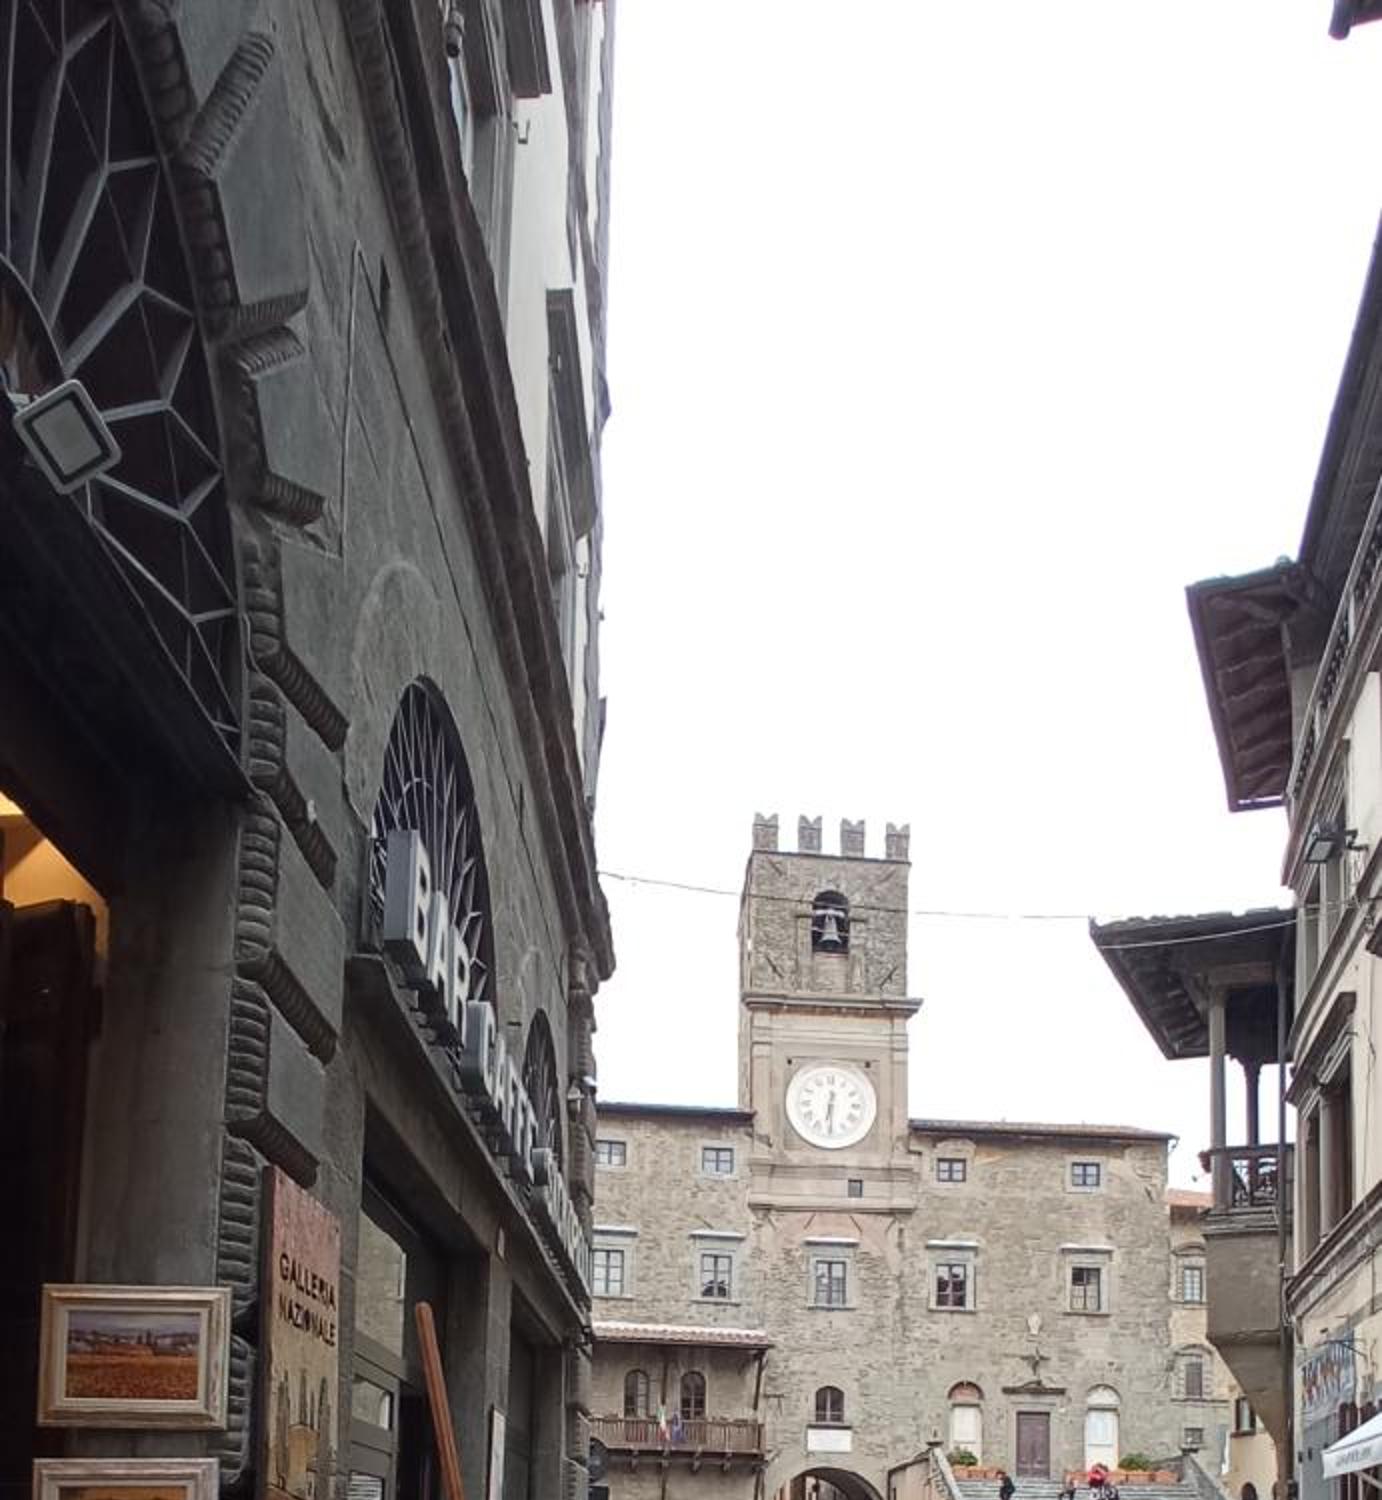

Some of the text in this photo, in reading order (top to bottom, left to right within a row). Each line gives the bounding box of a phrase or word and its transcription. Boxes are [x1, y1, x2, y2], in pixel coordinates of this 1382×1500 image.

[402, 828, 470, 1047] BAR
[279, 1251, 337, 1312] GALLERIA
[279, 1291, 336, 1347] NAZIONALE
